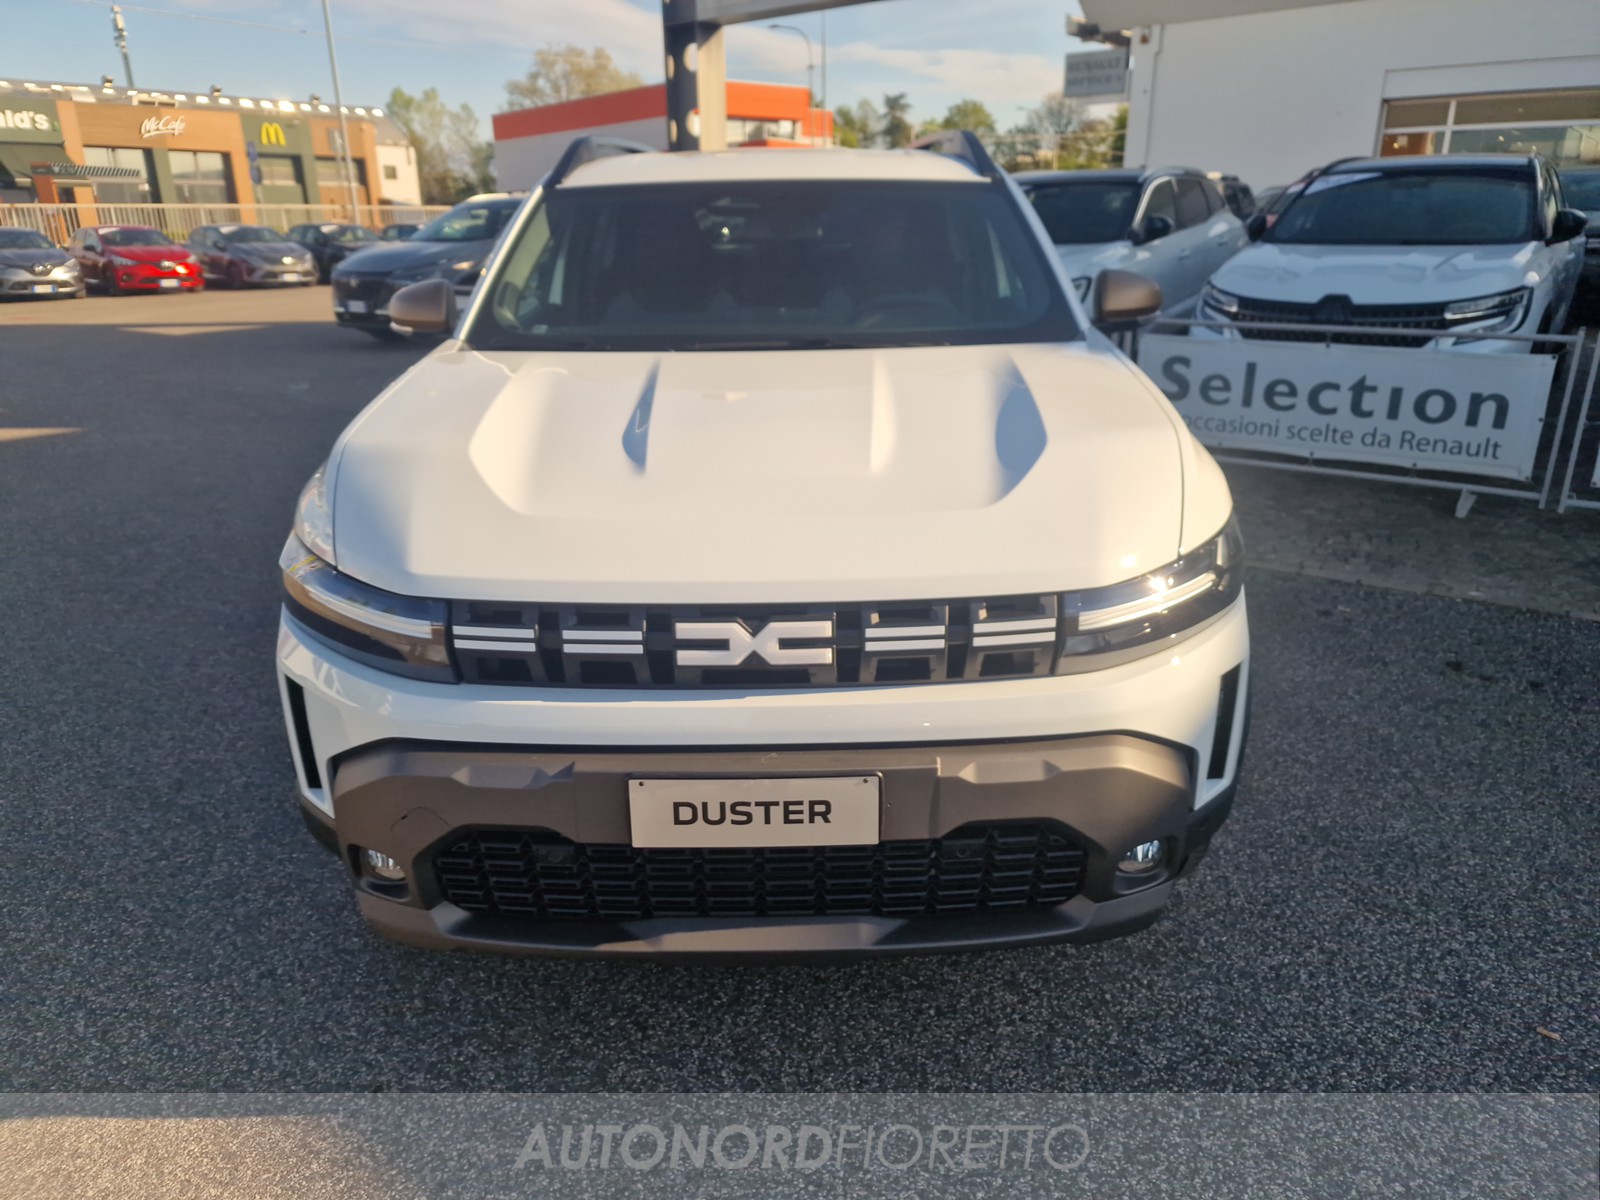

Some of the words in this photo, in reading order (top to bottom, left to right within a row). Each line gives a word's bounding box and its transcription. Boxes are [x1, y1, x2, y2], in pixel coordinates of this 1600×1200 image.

[1161, 355, 1510, 430] Selection
[1285, 422, 1354, 446] scelte
[1360, 426, 1392, 449] da
[1399, 430, 1503, 461] Renault
[672, 799, 833, 826] DUSTER
